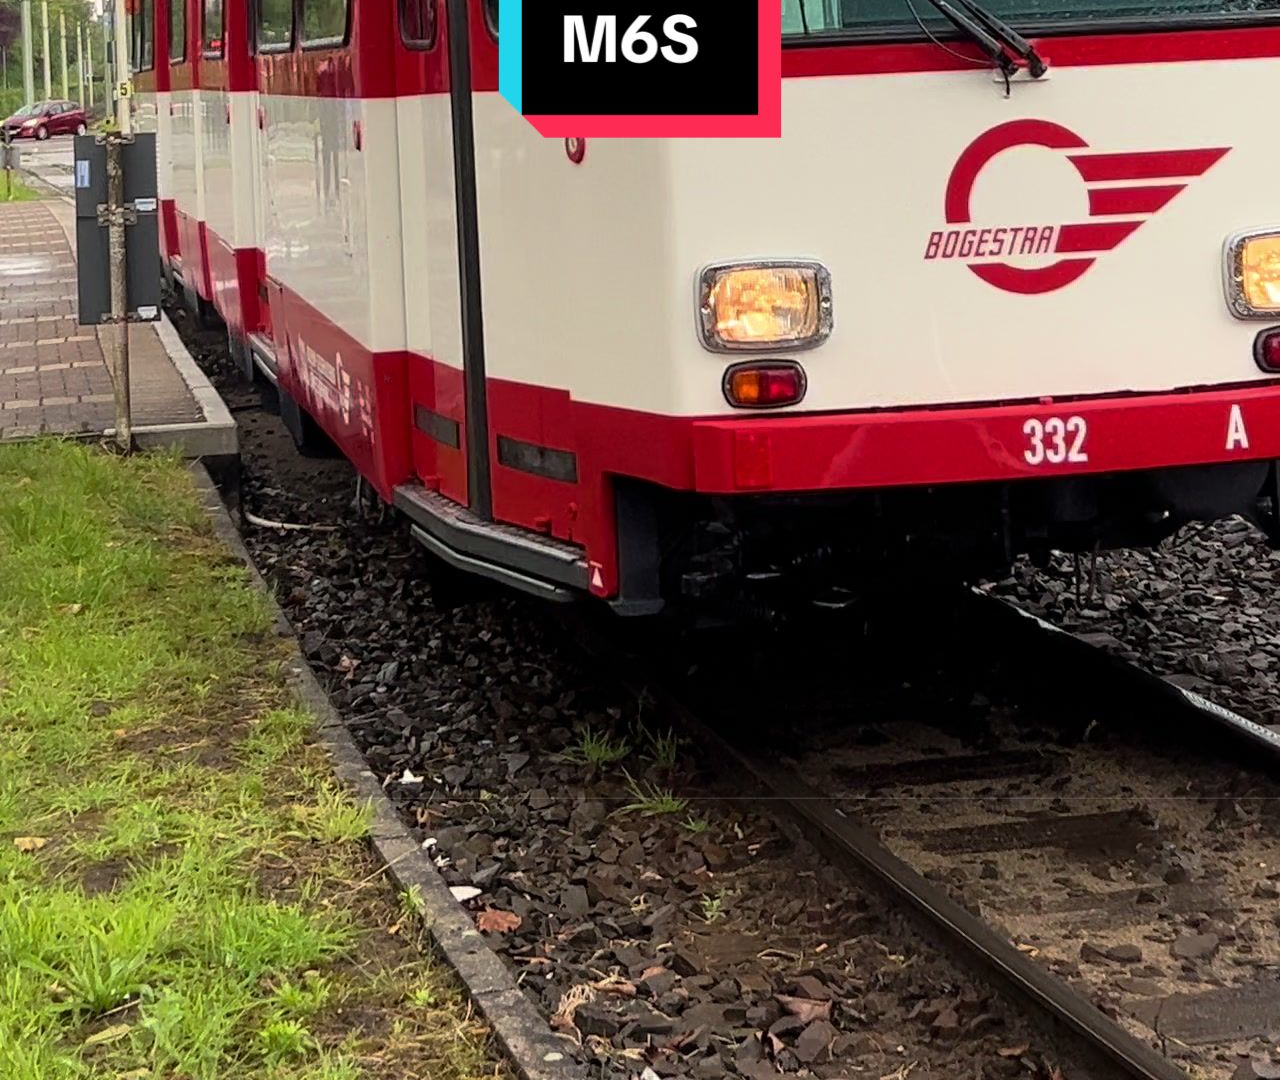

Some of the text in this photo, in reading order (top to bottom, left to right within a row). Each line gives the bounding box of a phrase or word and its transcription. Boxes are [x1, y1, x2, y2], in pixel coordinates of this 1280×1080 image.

[120, 82, 128, 96] 5
[924, 226, 1054, 259] BOGESTRA
[1023, 415, 1088, 465] 332
[1225, 404, 1249, 450] A
